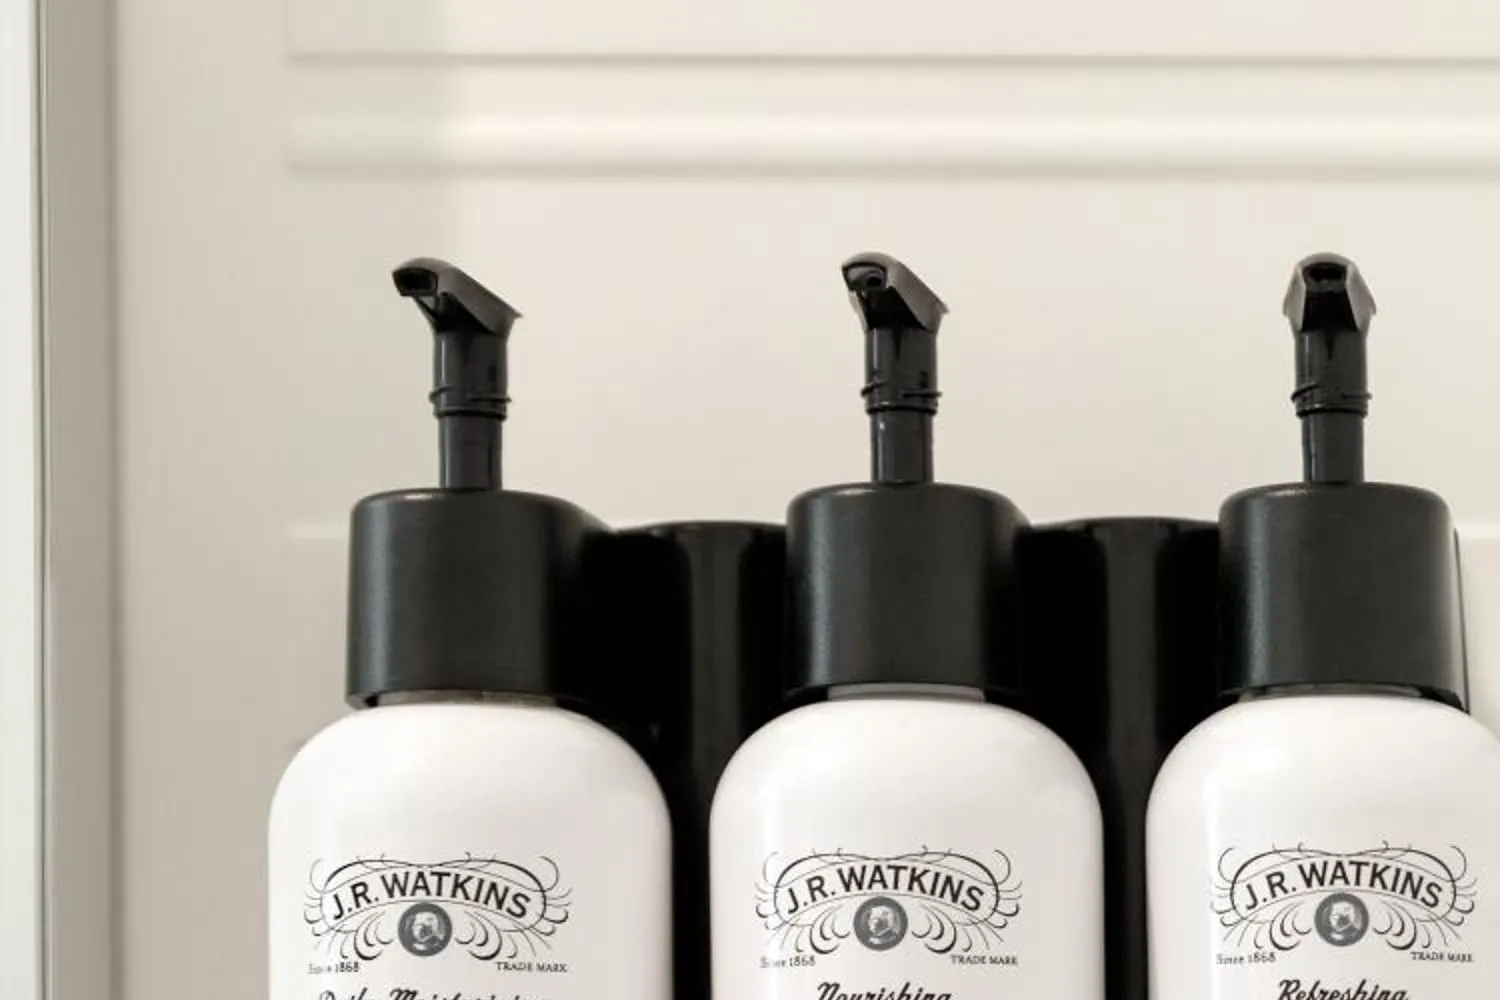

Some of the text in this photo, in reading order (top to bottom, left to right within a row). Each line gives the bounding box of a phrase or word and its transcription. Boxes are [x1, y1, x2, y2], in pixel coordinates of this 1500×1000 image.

[837, 864, 985, 912] WATKINS
[1297, 860, 1443, 908] WATKINS
[380, 870, 531, 919] WATKINS
[951, 955, 1018, 966] TRADE MARK
[1410, 951, 1444, 962] TRADE
[335, 961, 360, 974] 1868
[495, 961, 568, 973] TRADE MARK
